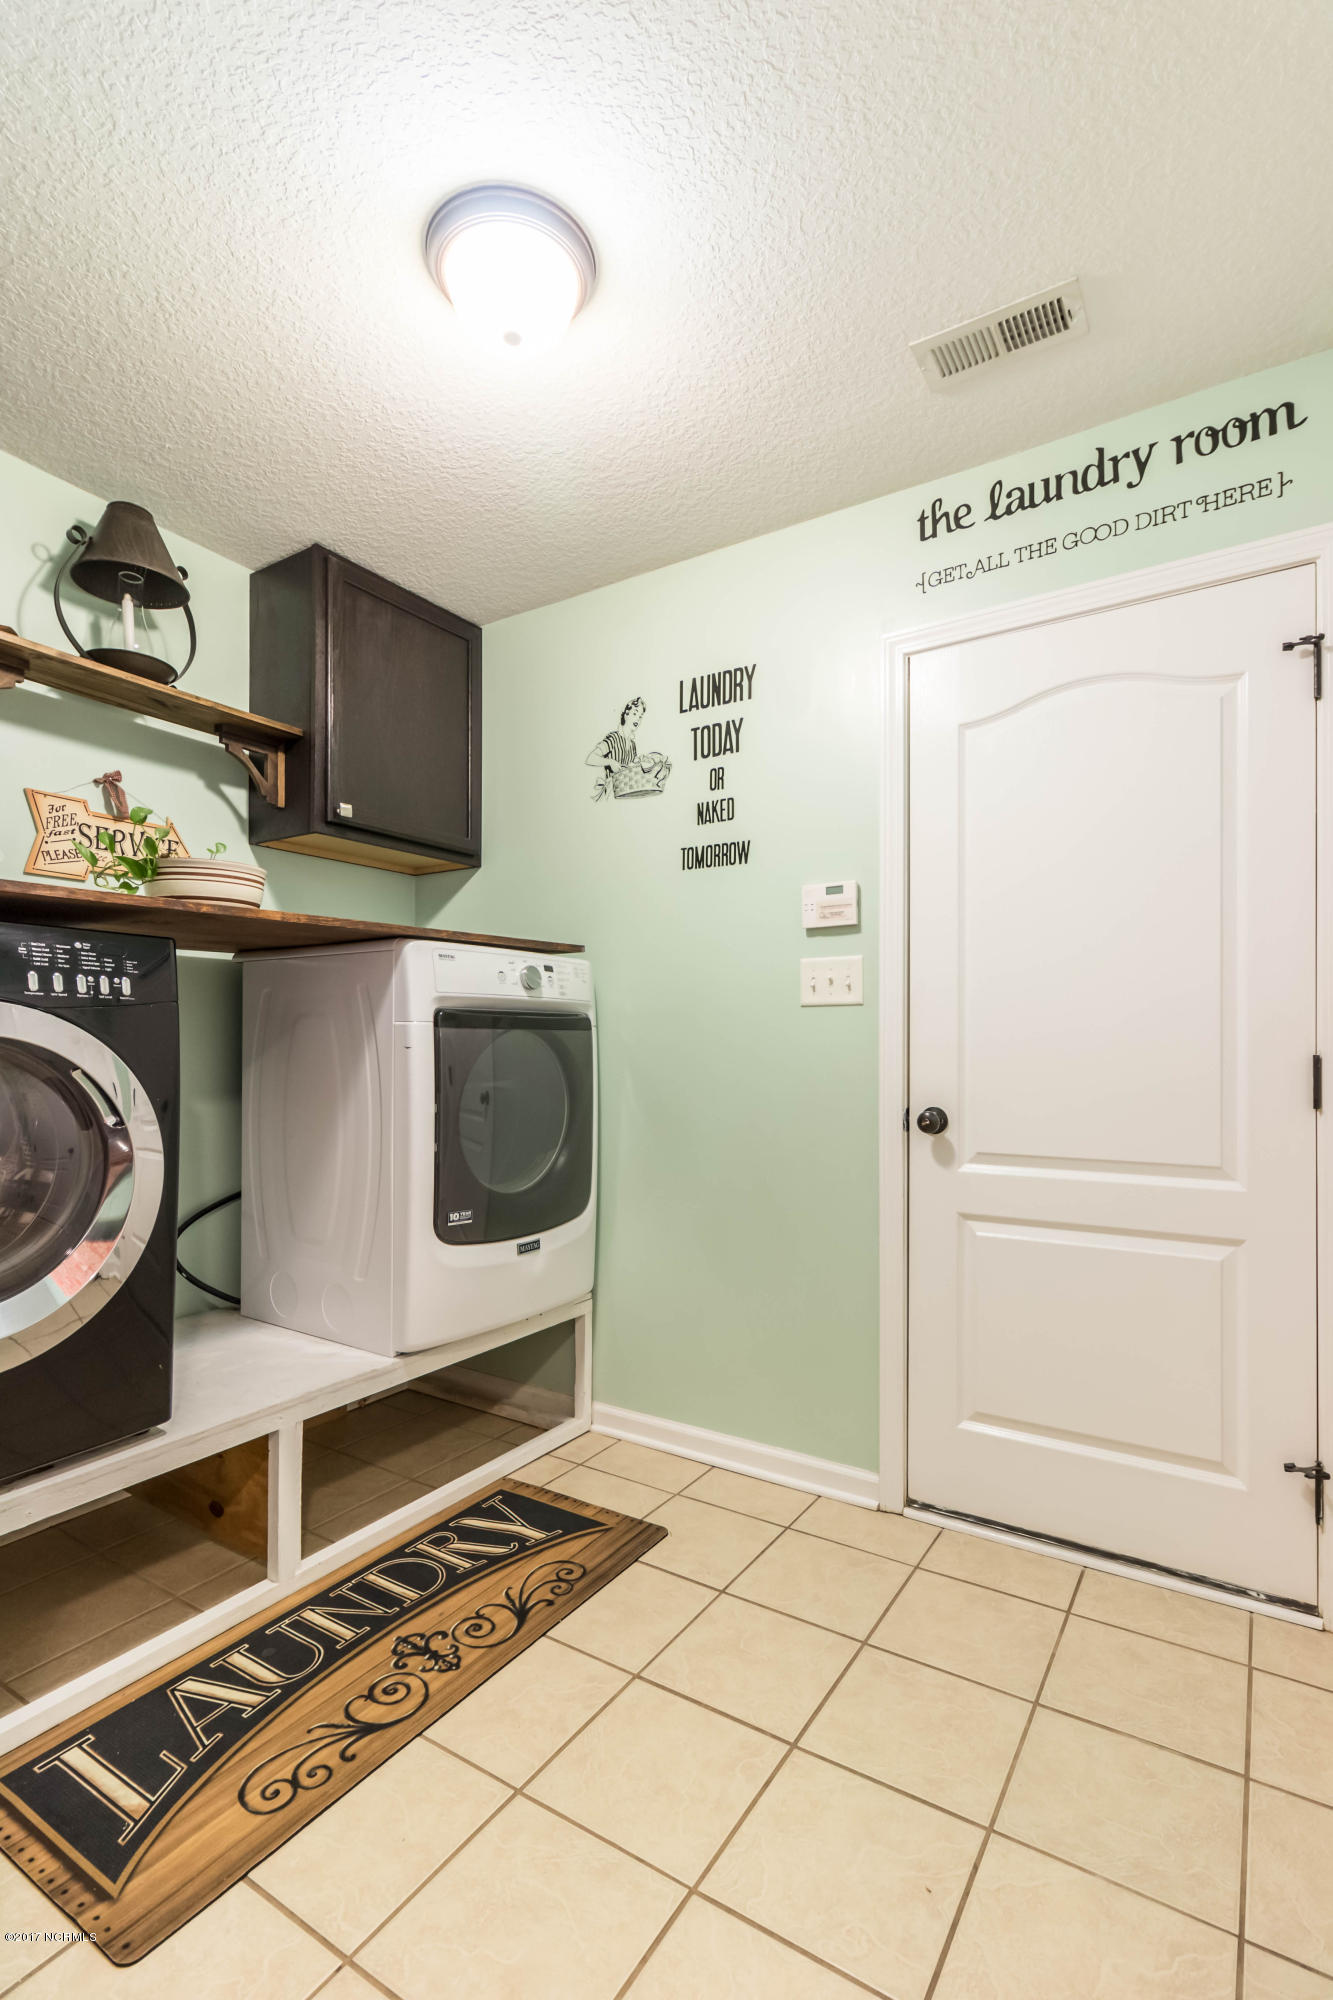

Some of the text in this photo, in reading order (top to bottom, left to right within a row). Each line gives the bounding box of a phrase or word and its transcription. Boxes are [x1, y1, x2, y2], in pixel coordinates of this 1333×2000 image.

[916, 400, 1309, 542] the laundry room
[965, 551, 1010, 580] ALL
[1013, 537, 1058, 564] THE
[1062, 517, 1130, 552] GOOD
[1134, 500, 1193, 532] DIRT
[678, 663, 757, 714] LAUNDRY
[690, 717, 744, 761] TODAY
[709, 766, 725, 792] OR
[696, 796, 735, 826] NAKED
[680, 839, 751, 871] TOMORROW
[449, 1212, 460, 1222] 10
[32, 1494, 564, 1847] LAUNDRY
